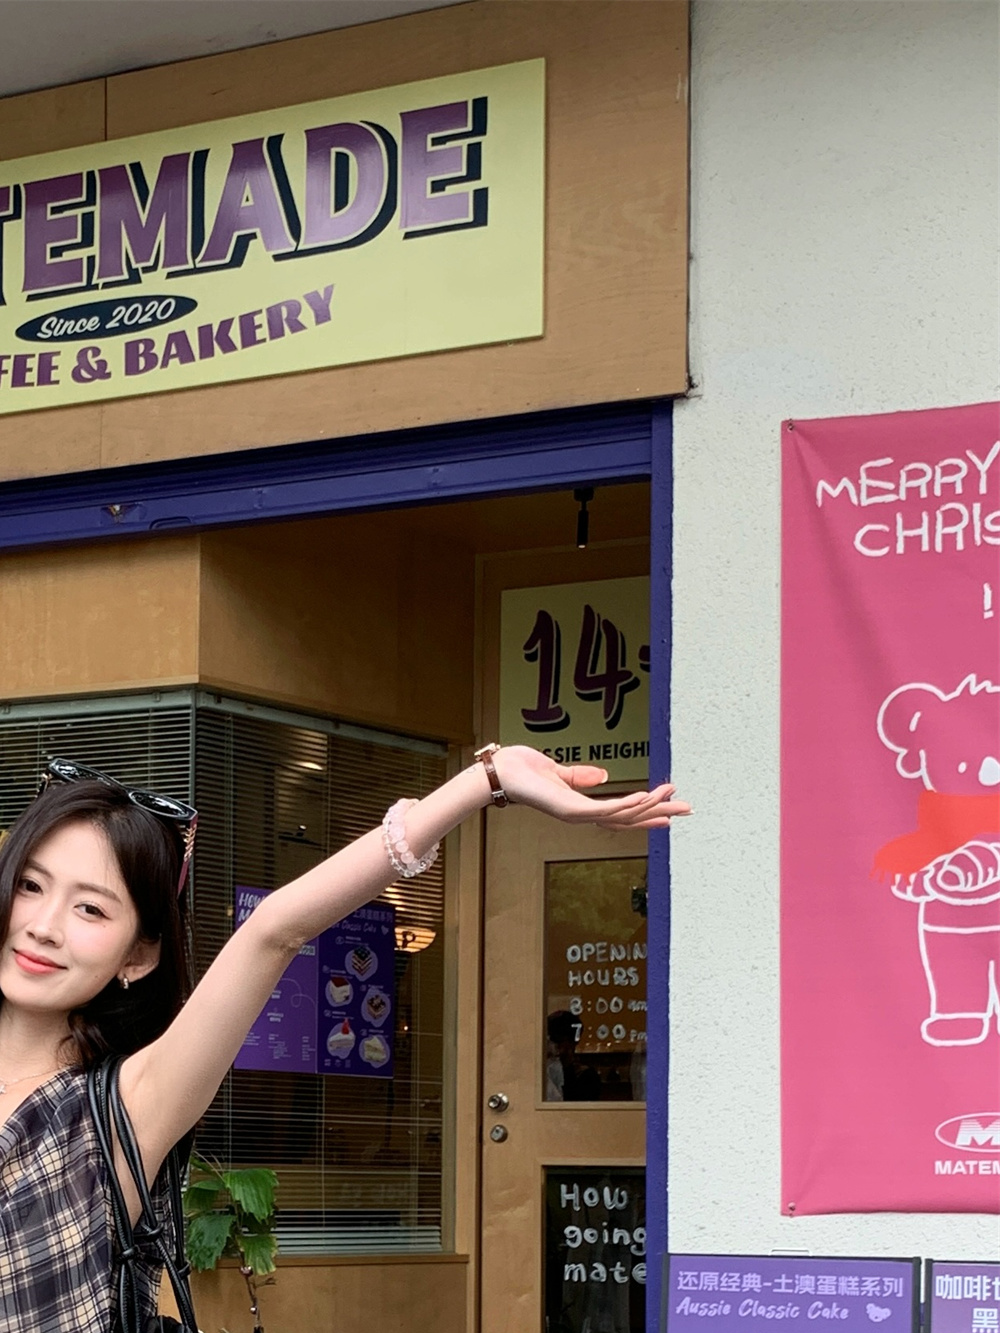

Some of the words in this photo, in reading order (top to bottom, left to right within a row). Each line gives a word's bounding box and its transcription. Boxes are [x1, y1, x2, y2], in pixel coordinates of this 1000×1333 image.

[36, 314, 99, 339] Since
[106, 299, 175, 329] 2020
[71, 346, 111, 383] &
[124, 283, 335, 376] BAKERY
[816, 440, 1000, 507] MERRY
[521, 604, 650, 733] 14
[538, 745, 581, 764] SSIE
[589, 741, 650, 760] NEIGH
[568, 967, 639, 987] HOURS
[560, 1183, 628, 1211] How
[563, 1222, 646, 1256] going
[564, 1262, 646, 1284] mate
[677, 1271, 904, 1298] 还原经典-土澳蛋糕系列
[676, 1297, 731, 1317] Aussie
[738, 1299, 800, 1320] Classic
[807, 1301, 849, 1320] Cake
[971, 1307, 999, 1333] 黑
